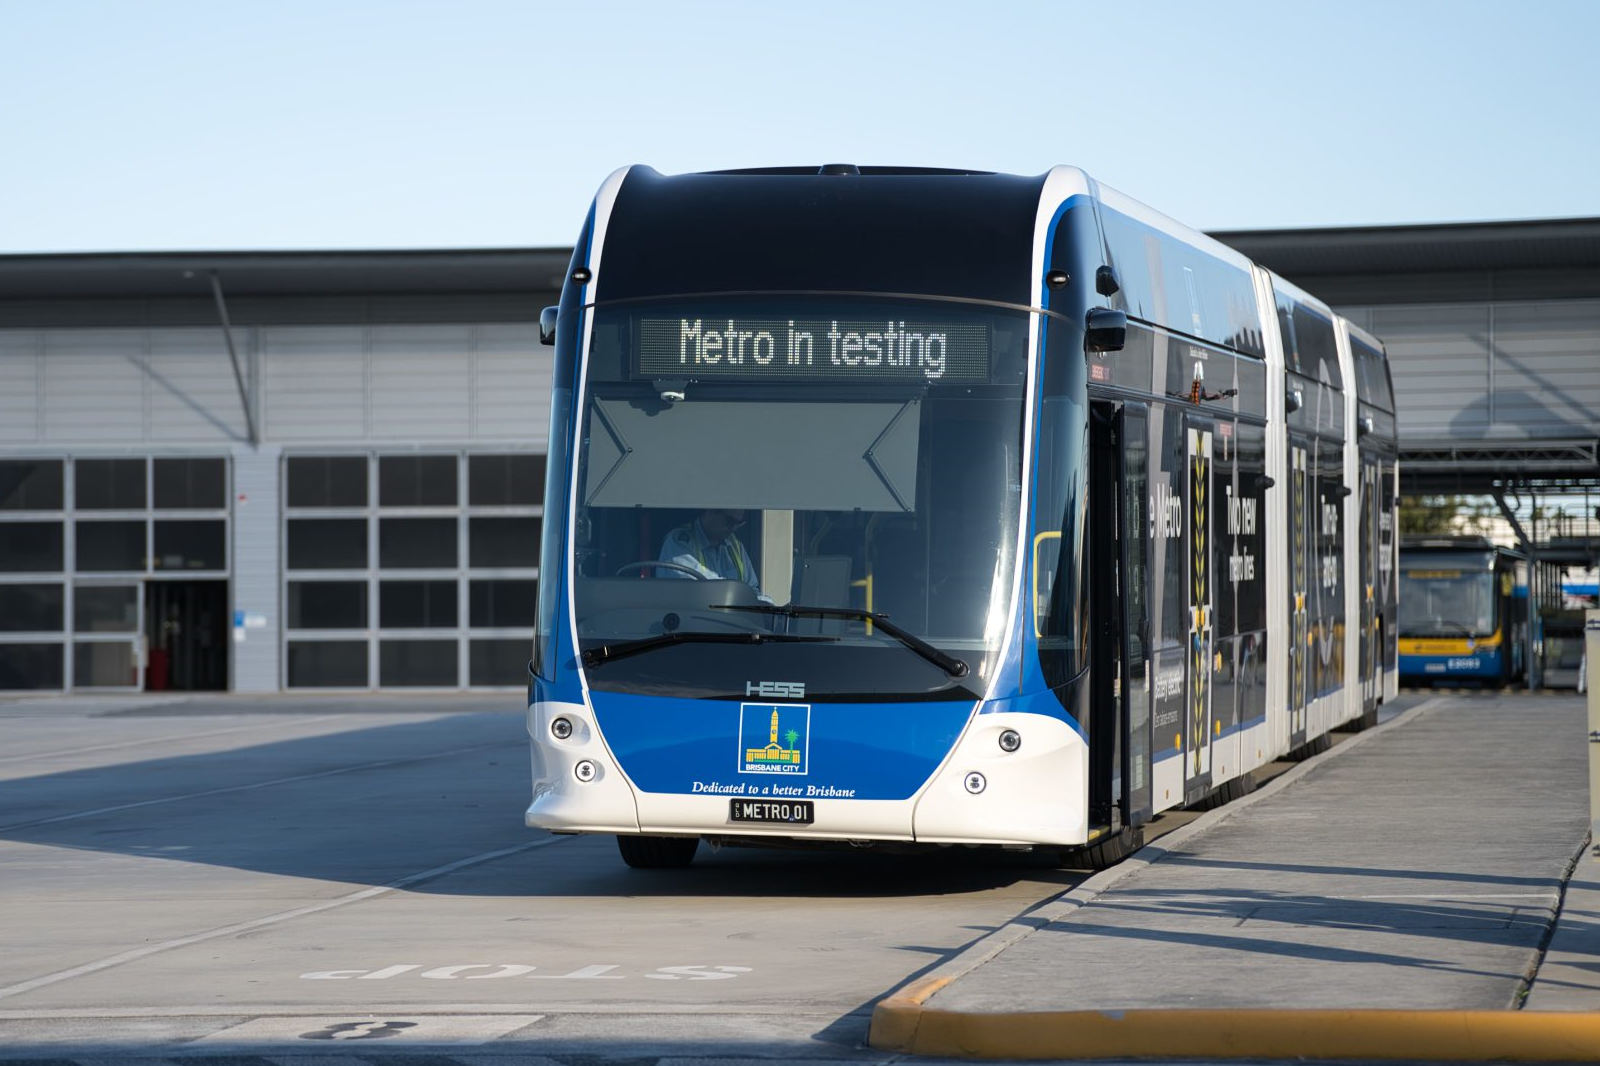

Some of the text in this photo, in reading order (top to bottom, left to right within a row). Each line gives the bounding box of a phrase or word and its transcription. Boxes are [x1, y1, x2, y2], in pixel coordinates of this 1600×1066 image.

[680, 319, 947, 378] Metro in testing
[1156, 482, 1182, 538] Metro
[746, 681, 805, 698] HESS
[745, 763, 800, 773] BRISBANE CITY
[692, 781, 856, 798] Dedicated to a better Brisbane
[299, 964, 753, 980] STOP
[298, 1021, 419, 1040] 8
